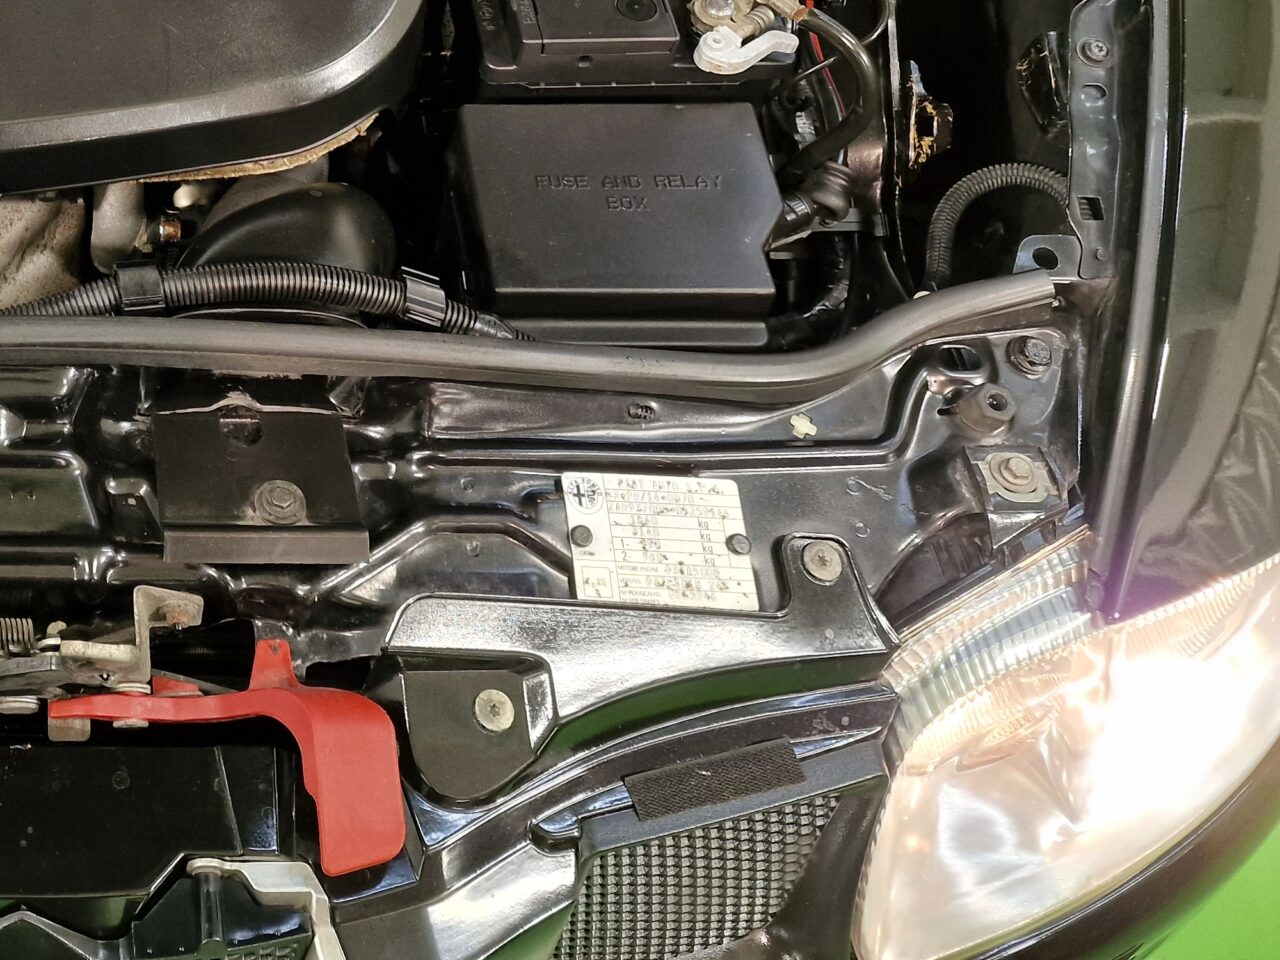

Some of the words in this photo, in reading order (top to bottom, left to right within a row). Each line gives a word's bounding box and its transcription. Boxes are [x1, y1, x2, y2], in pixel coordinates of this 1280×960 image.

[534, 174, 589, 190] FUSE
[602, 174, 642, 190] AND
[654, 174, 722, 190] RELAY
[606, 196, 650, 212] BOX
[697, 518, 709, 530] kg
[699, 530, 711, 542] kg
[701, 544, 713, 554] kg
[703, 555, 715, 566] kg
